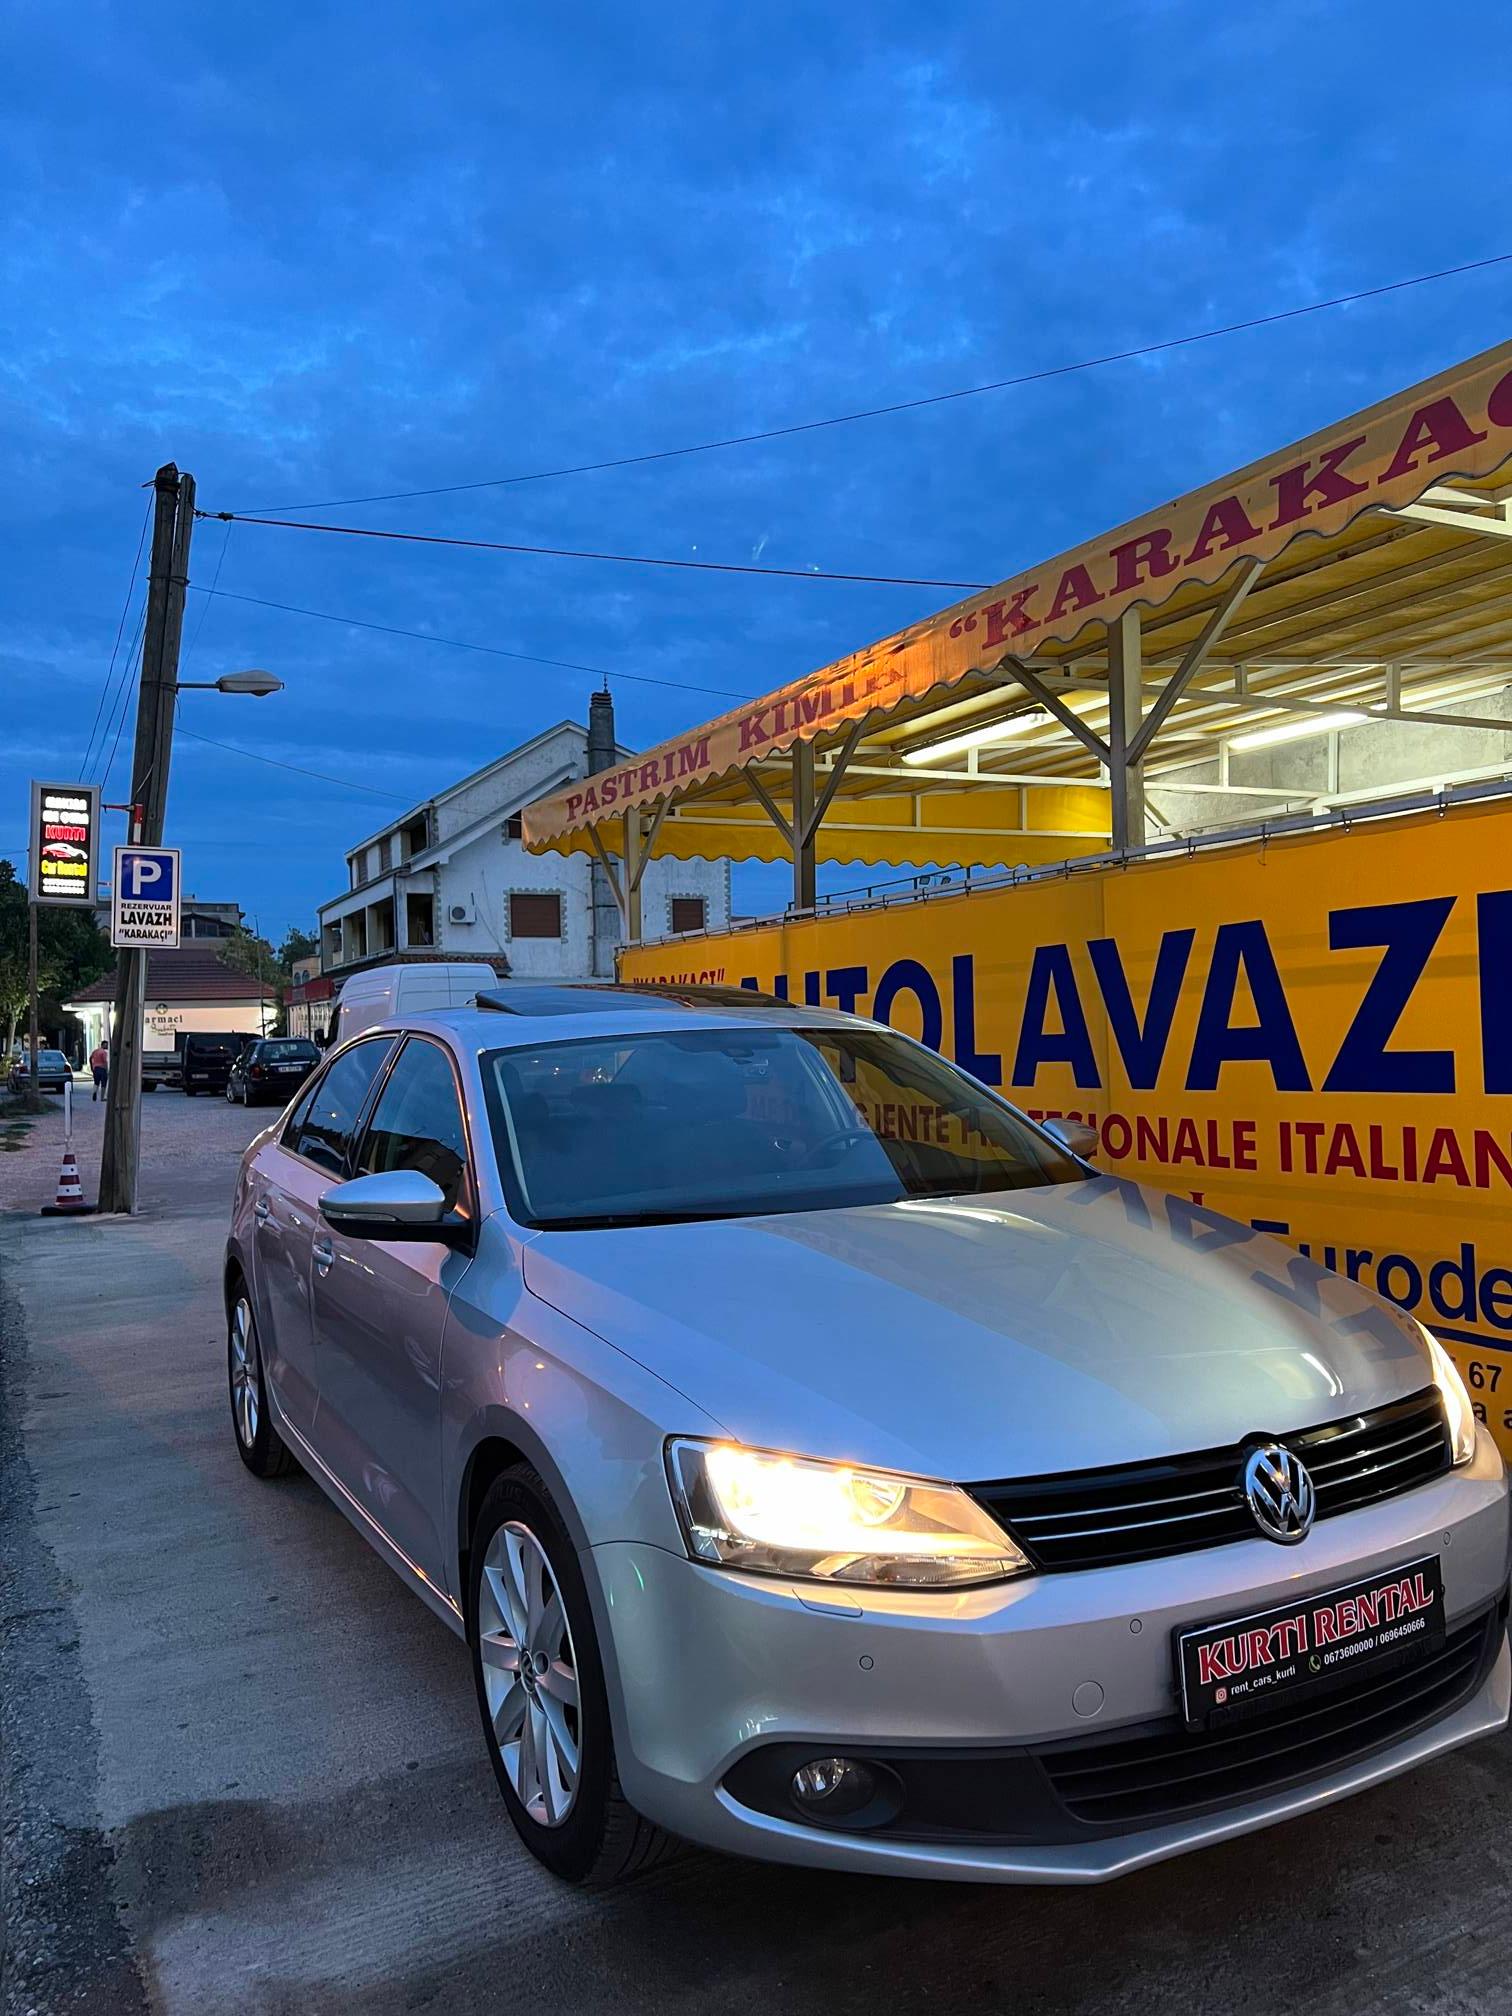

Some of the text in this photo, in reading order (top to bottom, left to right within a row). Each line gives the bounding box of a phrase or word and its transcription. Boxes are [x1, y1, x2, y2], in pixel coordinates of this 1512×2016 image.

[566, 736, 711, 822] PASTRIM
[121, 903, 172, 911] REZERVUAR
[133, 860, 162, 895] P
[121, 911, 172, 926] LAVAZH
[144, 1014, 183, 1024] armaci
[740, 889, 1512, 1095] TOLAVAZ
[1251, 1219, 1512, 1330] rode
[1198, 1573, 1434, 1685] KURTI RENTAL
[1231, 1665, 1296, 1695] rent_cars_kurti
[1324, 1637, 1374, 1665] 0673600000
[1379, 1617, 1426, 1644] 0696450666
